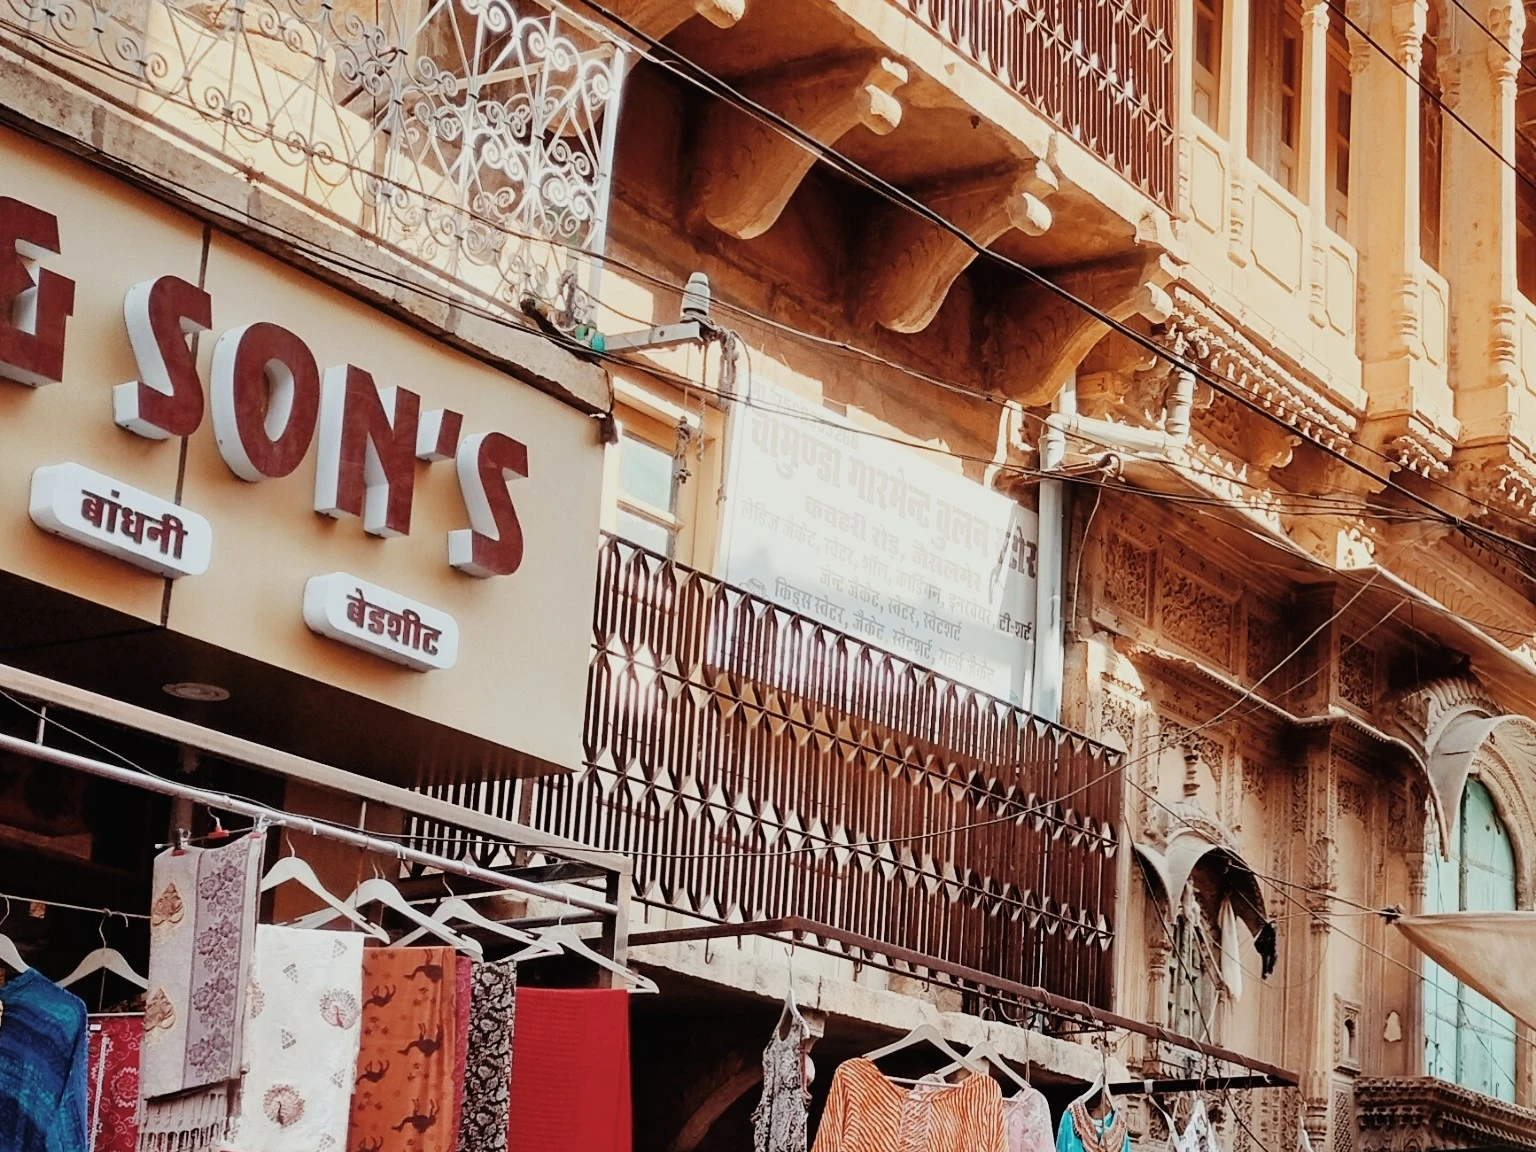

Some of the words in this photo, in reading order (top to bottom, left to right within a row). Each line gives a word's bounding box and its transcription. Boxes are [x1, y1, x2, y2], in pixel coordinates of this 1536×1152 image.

[114, 275, 529, 577] SON'S
[751, 411, 841, 489] चामुण्डा
[848, 457, 931, 529] गारमेन्ट
[81, 488, 189, 561] बांधनी
[805, 494, 866, 542] कचहरी
[346, 588, 442, 656] बेडशीट
